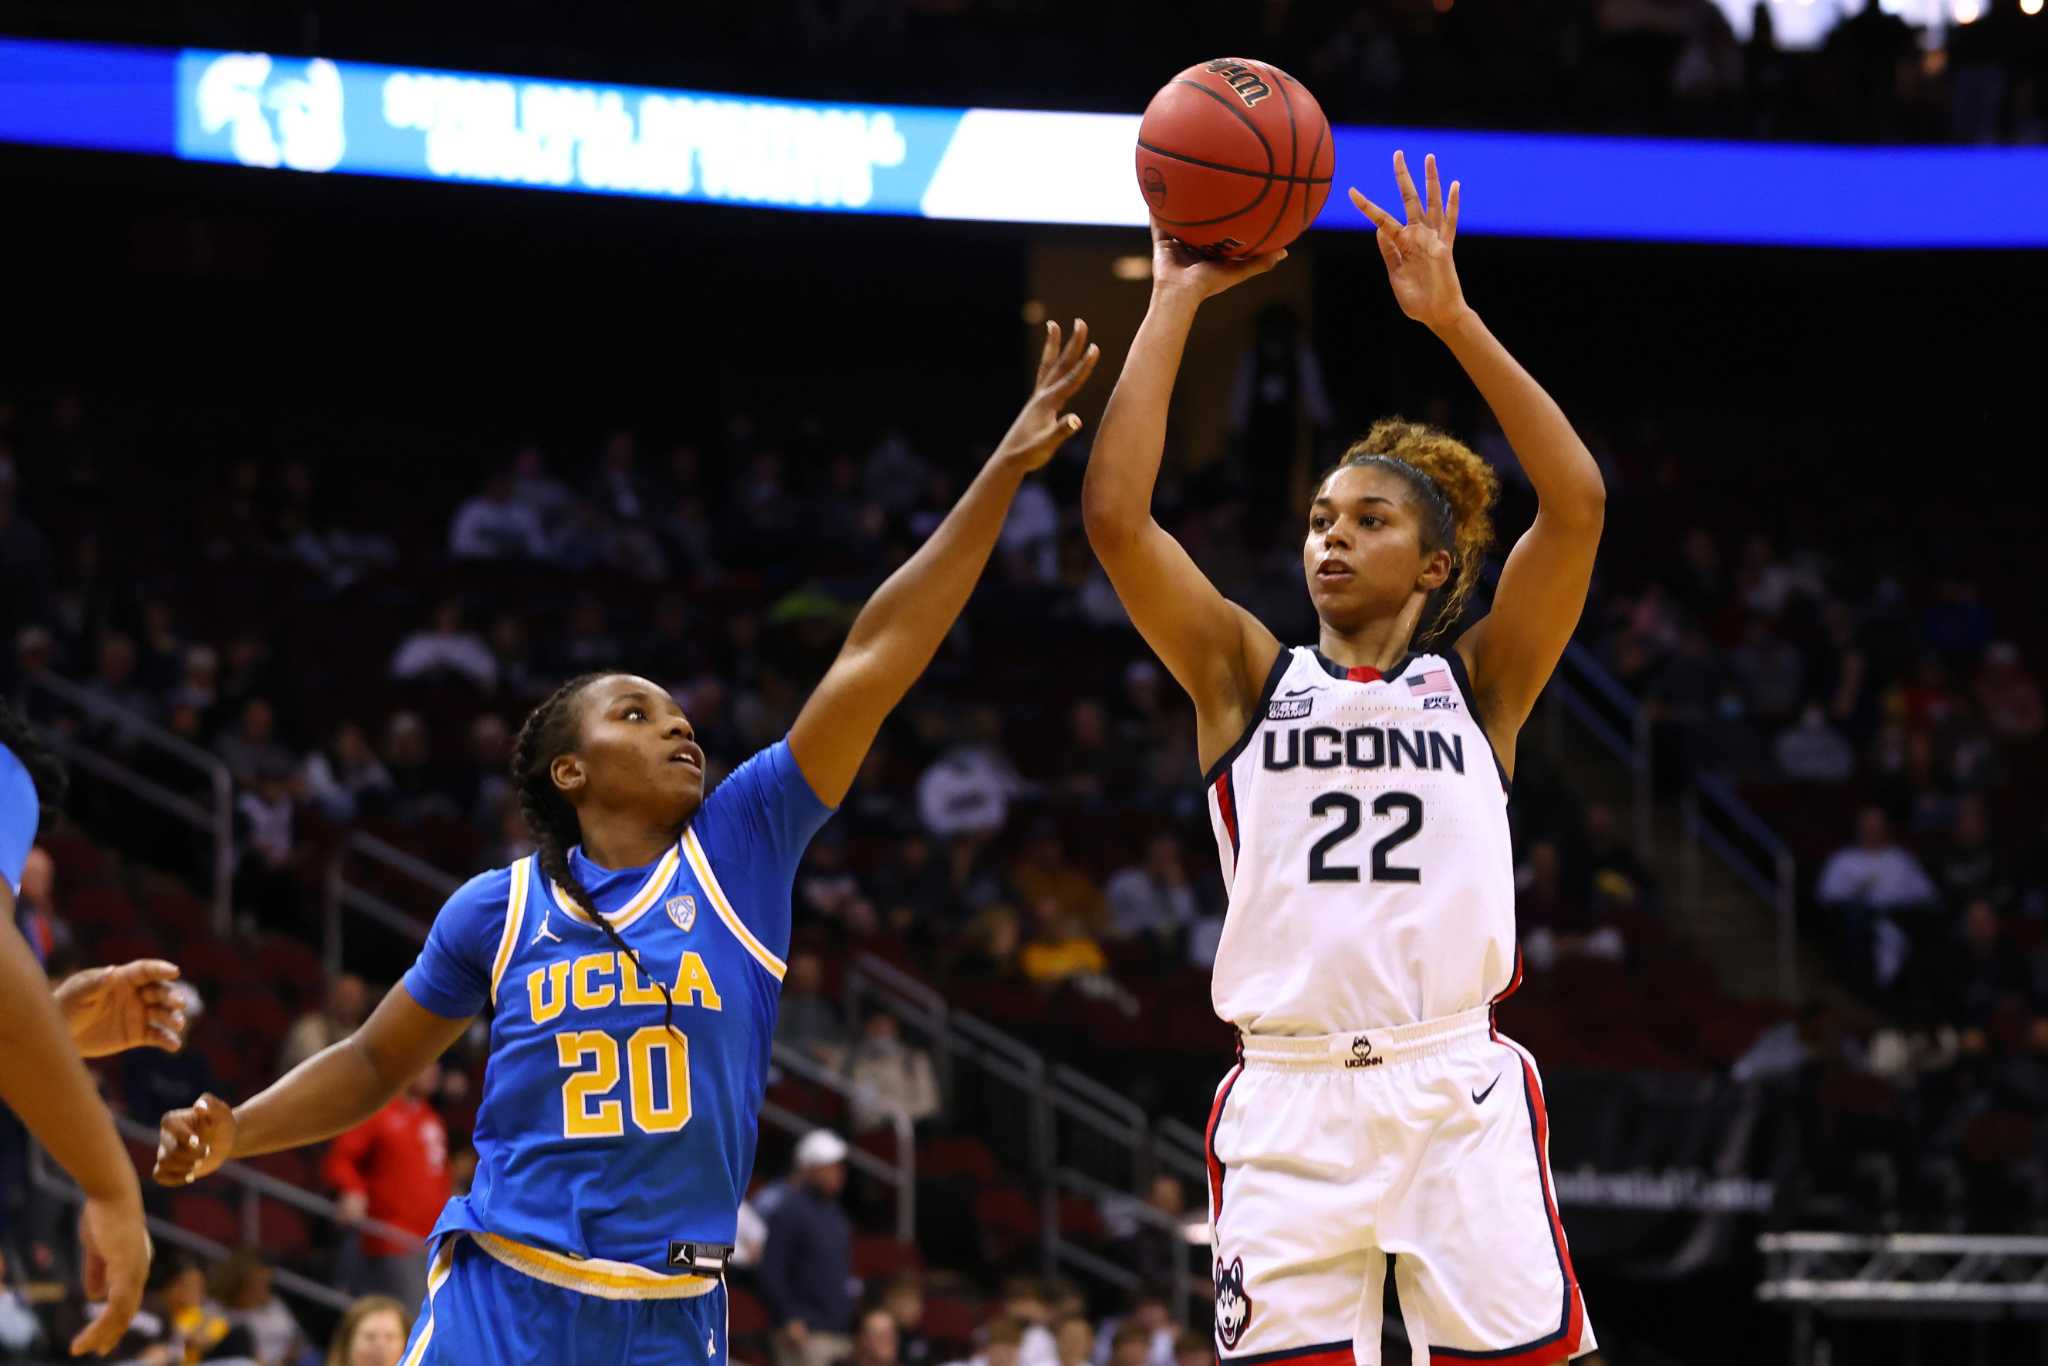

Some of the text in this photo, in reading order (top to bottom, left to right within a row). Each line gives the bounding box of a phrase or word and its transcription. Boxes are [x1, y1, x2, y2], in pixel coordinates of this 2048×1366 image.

[1263, 727, 1465, 775] UCONN
[1308, 791, 1423, 884] 22
[527, 950, 722, 1025] UCLA
[555, 1024, 693, 1139] 20
